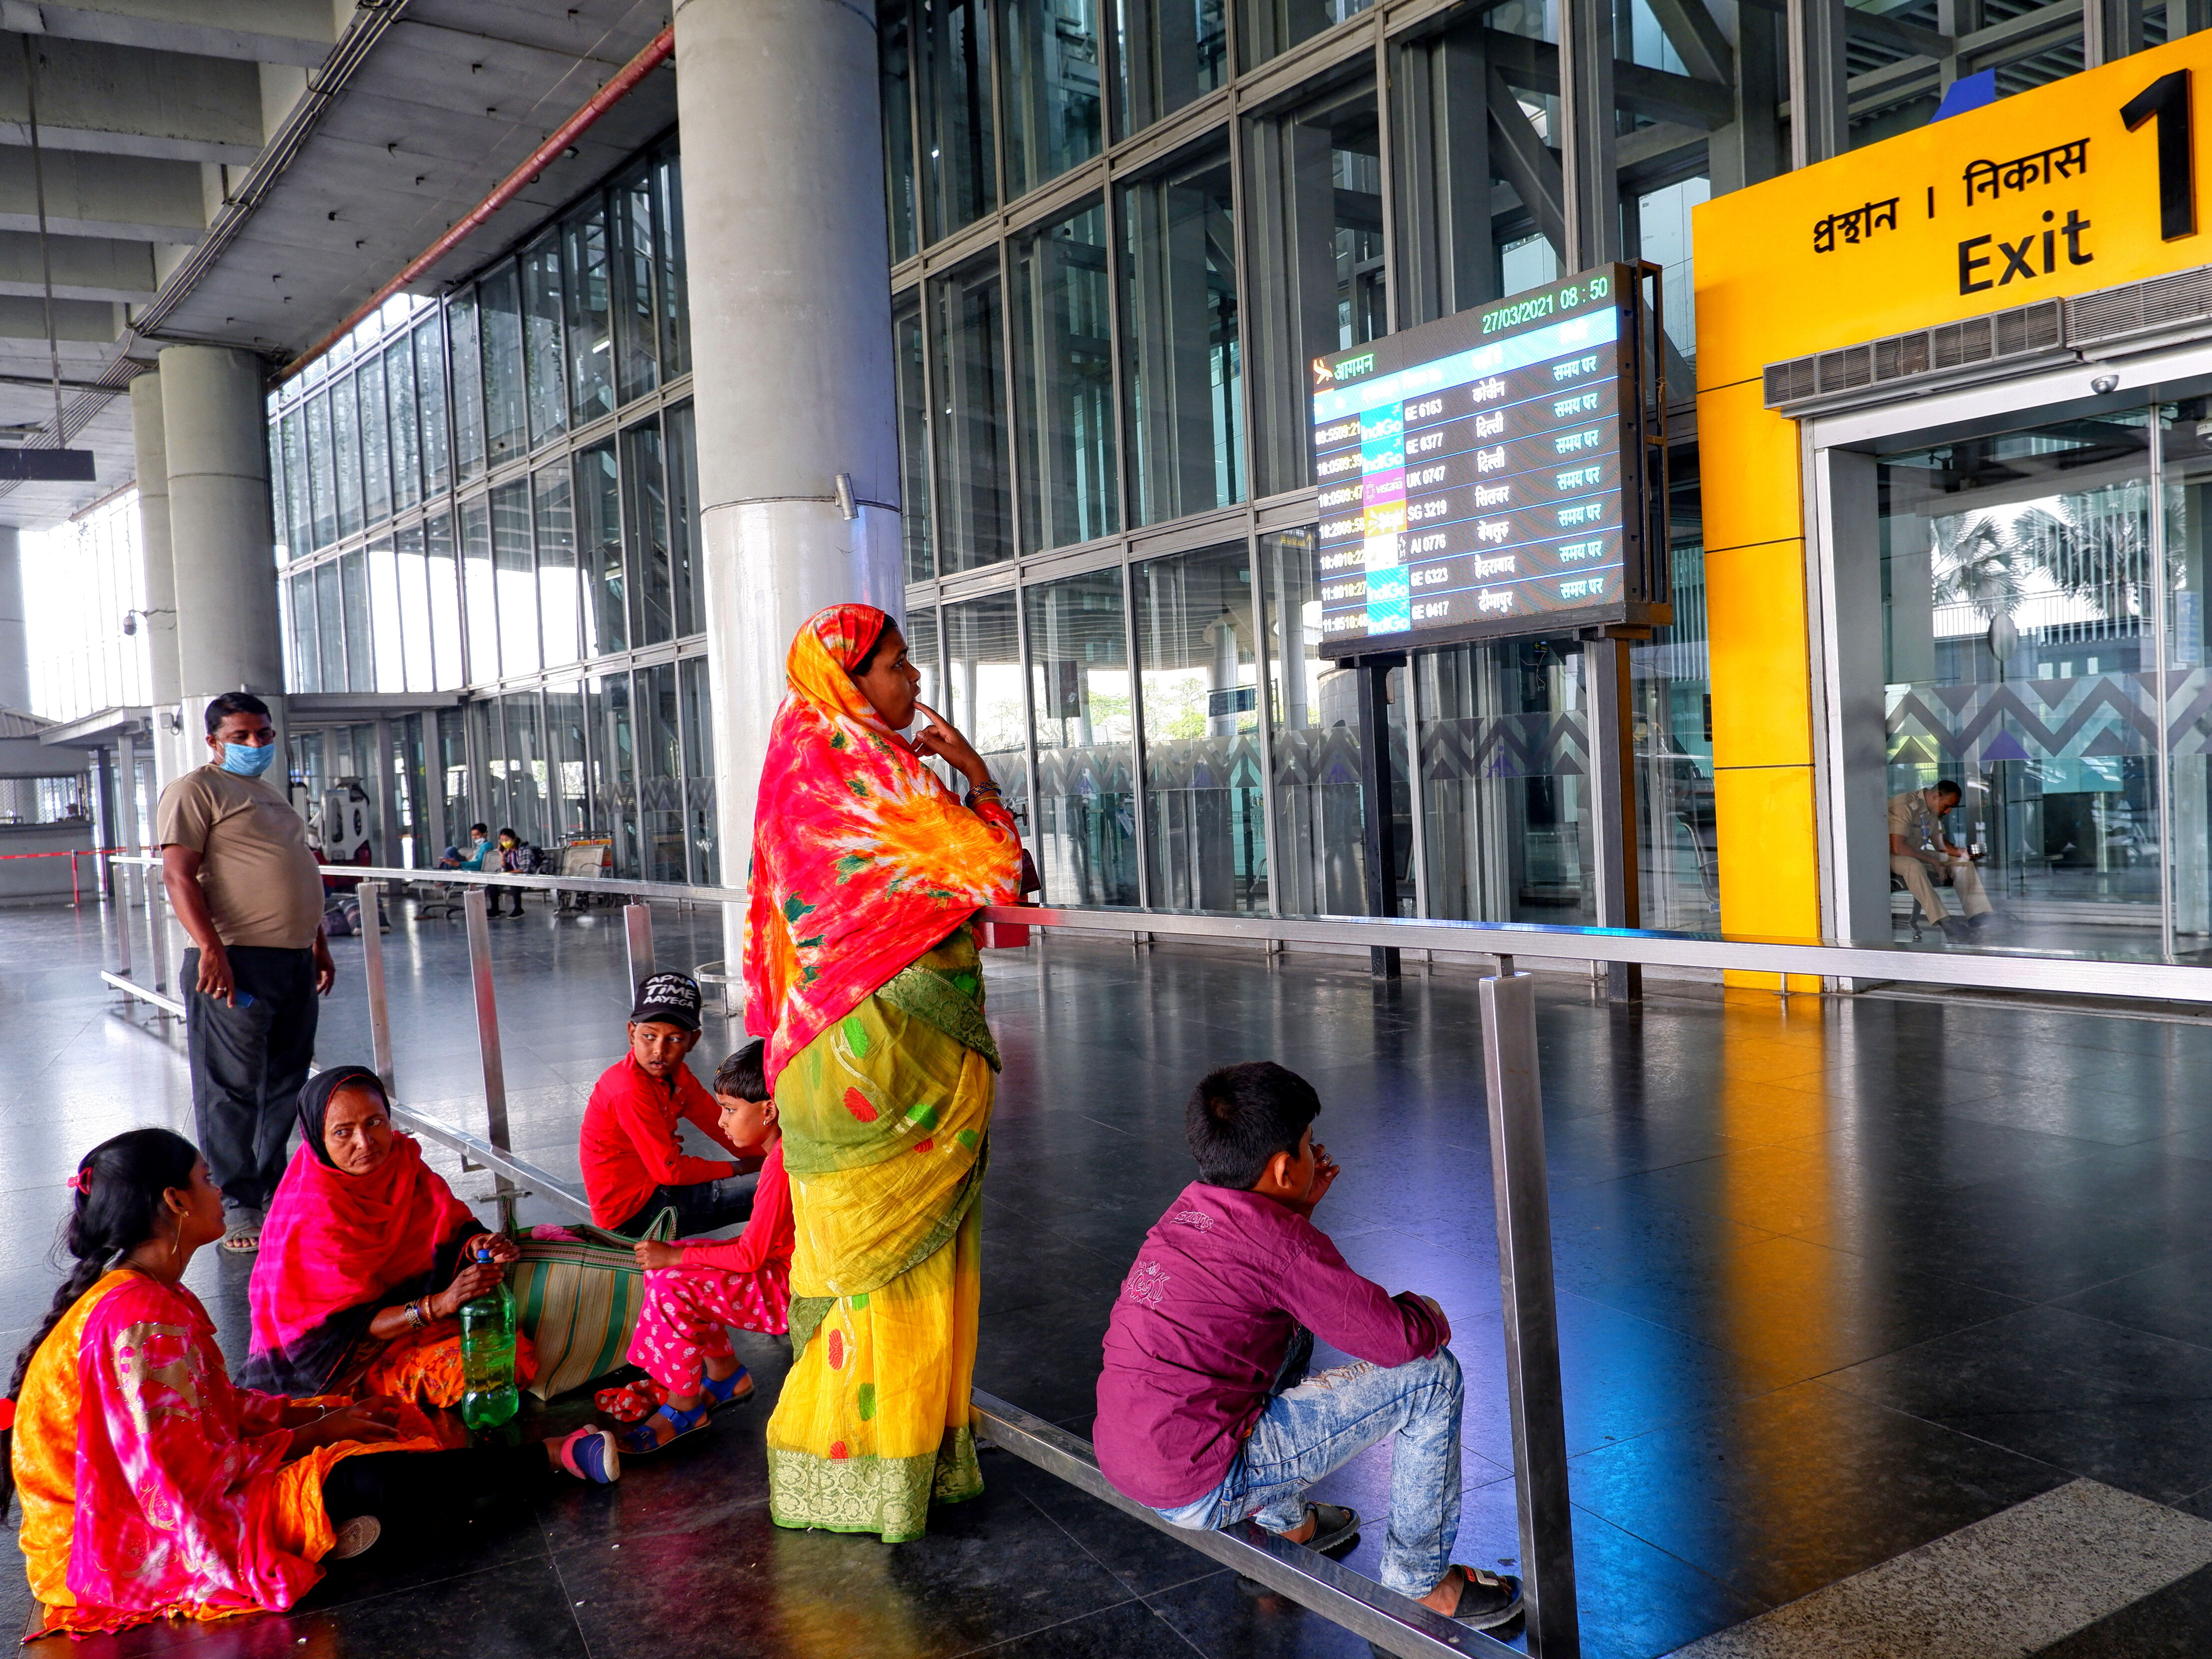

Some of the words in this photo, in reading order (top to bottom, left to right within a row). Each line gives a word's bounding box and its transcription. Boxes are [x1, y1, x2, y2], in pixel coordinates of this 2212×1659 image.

[2120, 68, 2197, 243] 1
[1814, 197, 1900, 253] প্রস্থান
[1963, 137, 2090, 206] निकास
[1959, 209, 2094, 296] Exit
[1482, 295, 1553, 333] 27/03/2021
[1334, 354, 1374, 380] आगमन
[1419, 399, 1443, 418] 6163
[1472, 377, 1505, 403] कोचीन
[1553, 360, 1580, 381] समय
[1581, 356, 1597, 373] पर
[1338, 453, 1363, 472] 09:39
[1475, 411, 1504, 438] दिल्ली
[1554, 397, 1581, 417] समय
[1582, 393, 1598, 410] पर
[1339, 485, 1363, 503] 09:47
[1406, 471, 1422, 489] UK
[1422, 465, 1446, 485] 0747
[1477, 446, 1505, 473] दिल्ली
[1555, 434, 1582, 454] समय
[1584, 430, 1598, 447] पर
[1341, 518, 1364, 535] 09:58
[1407, 504, 1423, 522] SG
[1424, 499, 1447, 518] 3219
[1557, 470, 1583, 491] समय
[1585, 467, 1600, 484] पर
[1410, 538, 1422, 554] AI
[1423, 534, 1446, 552] 0776
[1558, 507, 1584, 526] समय
[1586, 504, 1602, 520] पर
[1343, 581, 1367, 597] 10:27
[1425, 567, 1449, 584] 6323
[1474, 554, 1515, 579] हैदराबाद
[1559, 544, 1585, 563] समय
[1587, 541, 1603, 556] पर
[1478, 588, 1513, 613] दीमापुर
[1559, 580, 1586, 598] समय
[1588, 578, 1604, 594] पर
[642, 995, 694, 1009] AAYEGA
[646, 975, 696, 988] APNA
